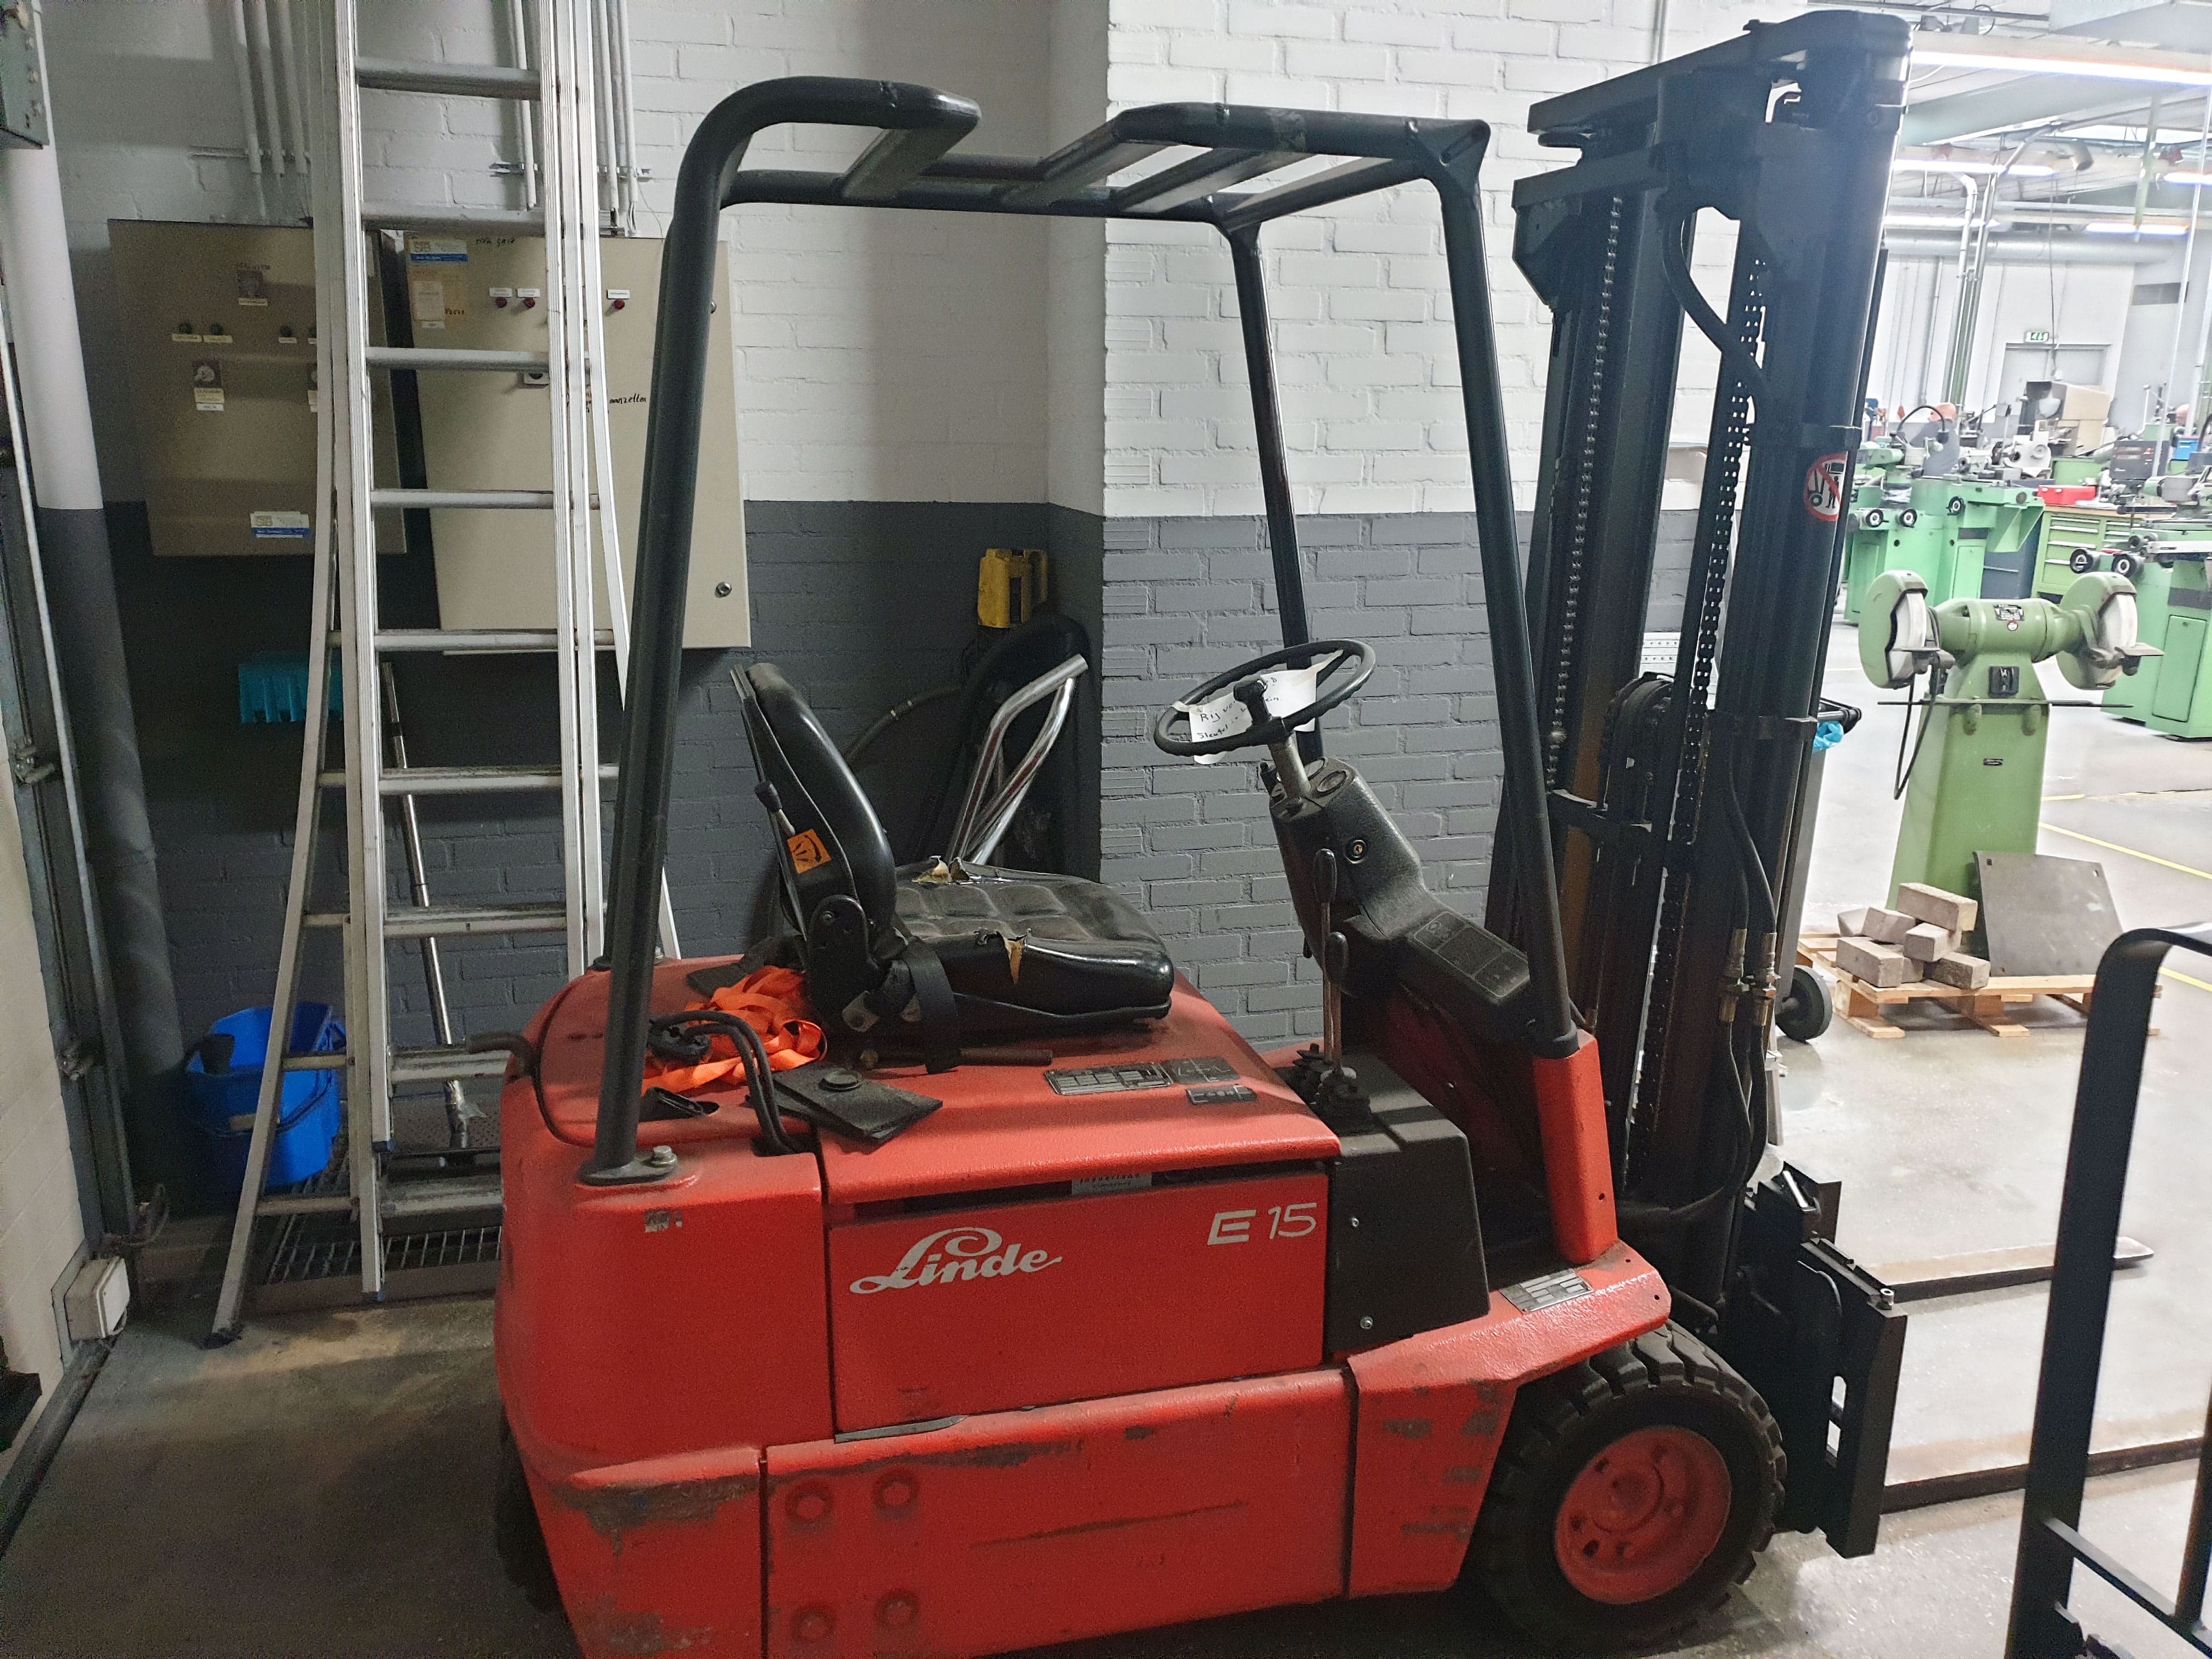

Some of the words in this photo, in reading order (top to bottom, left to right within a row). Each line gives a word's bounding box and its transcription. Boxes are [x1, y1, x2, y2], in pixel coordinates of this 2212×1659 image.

[1200, 710, 1221, 723] Rij
[1207, 1209, 1256, 1246] E
[1268, 1203, 1317, 1240] 15
[849, 1227, 1062, 1294] Linde
